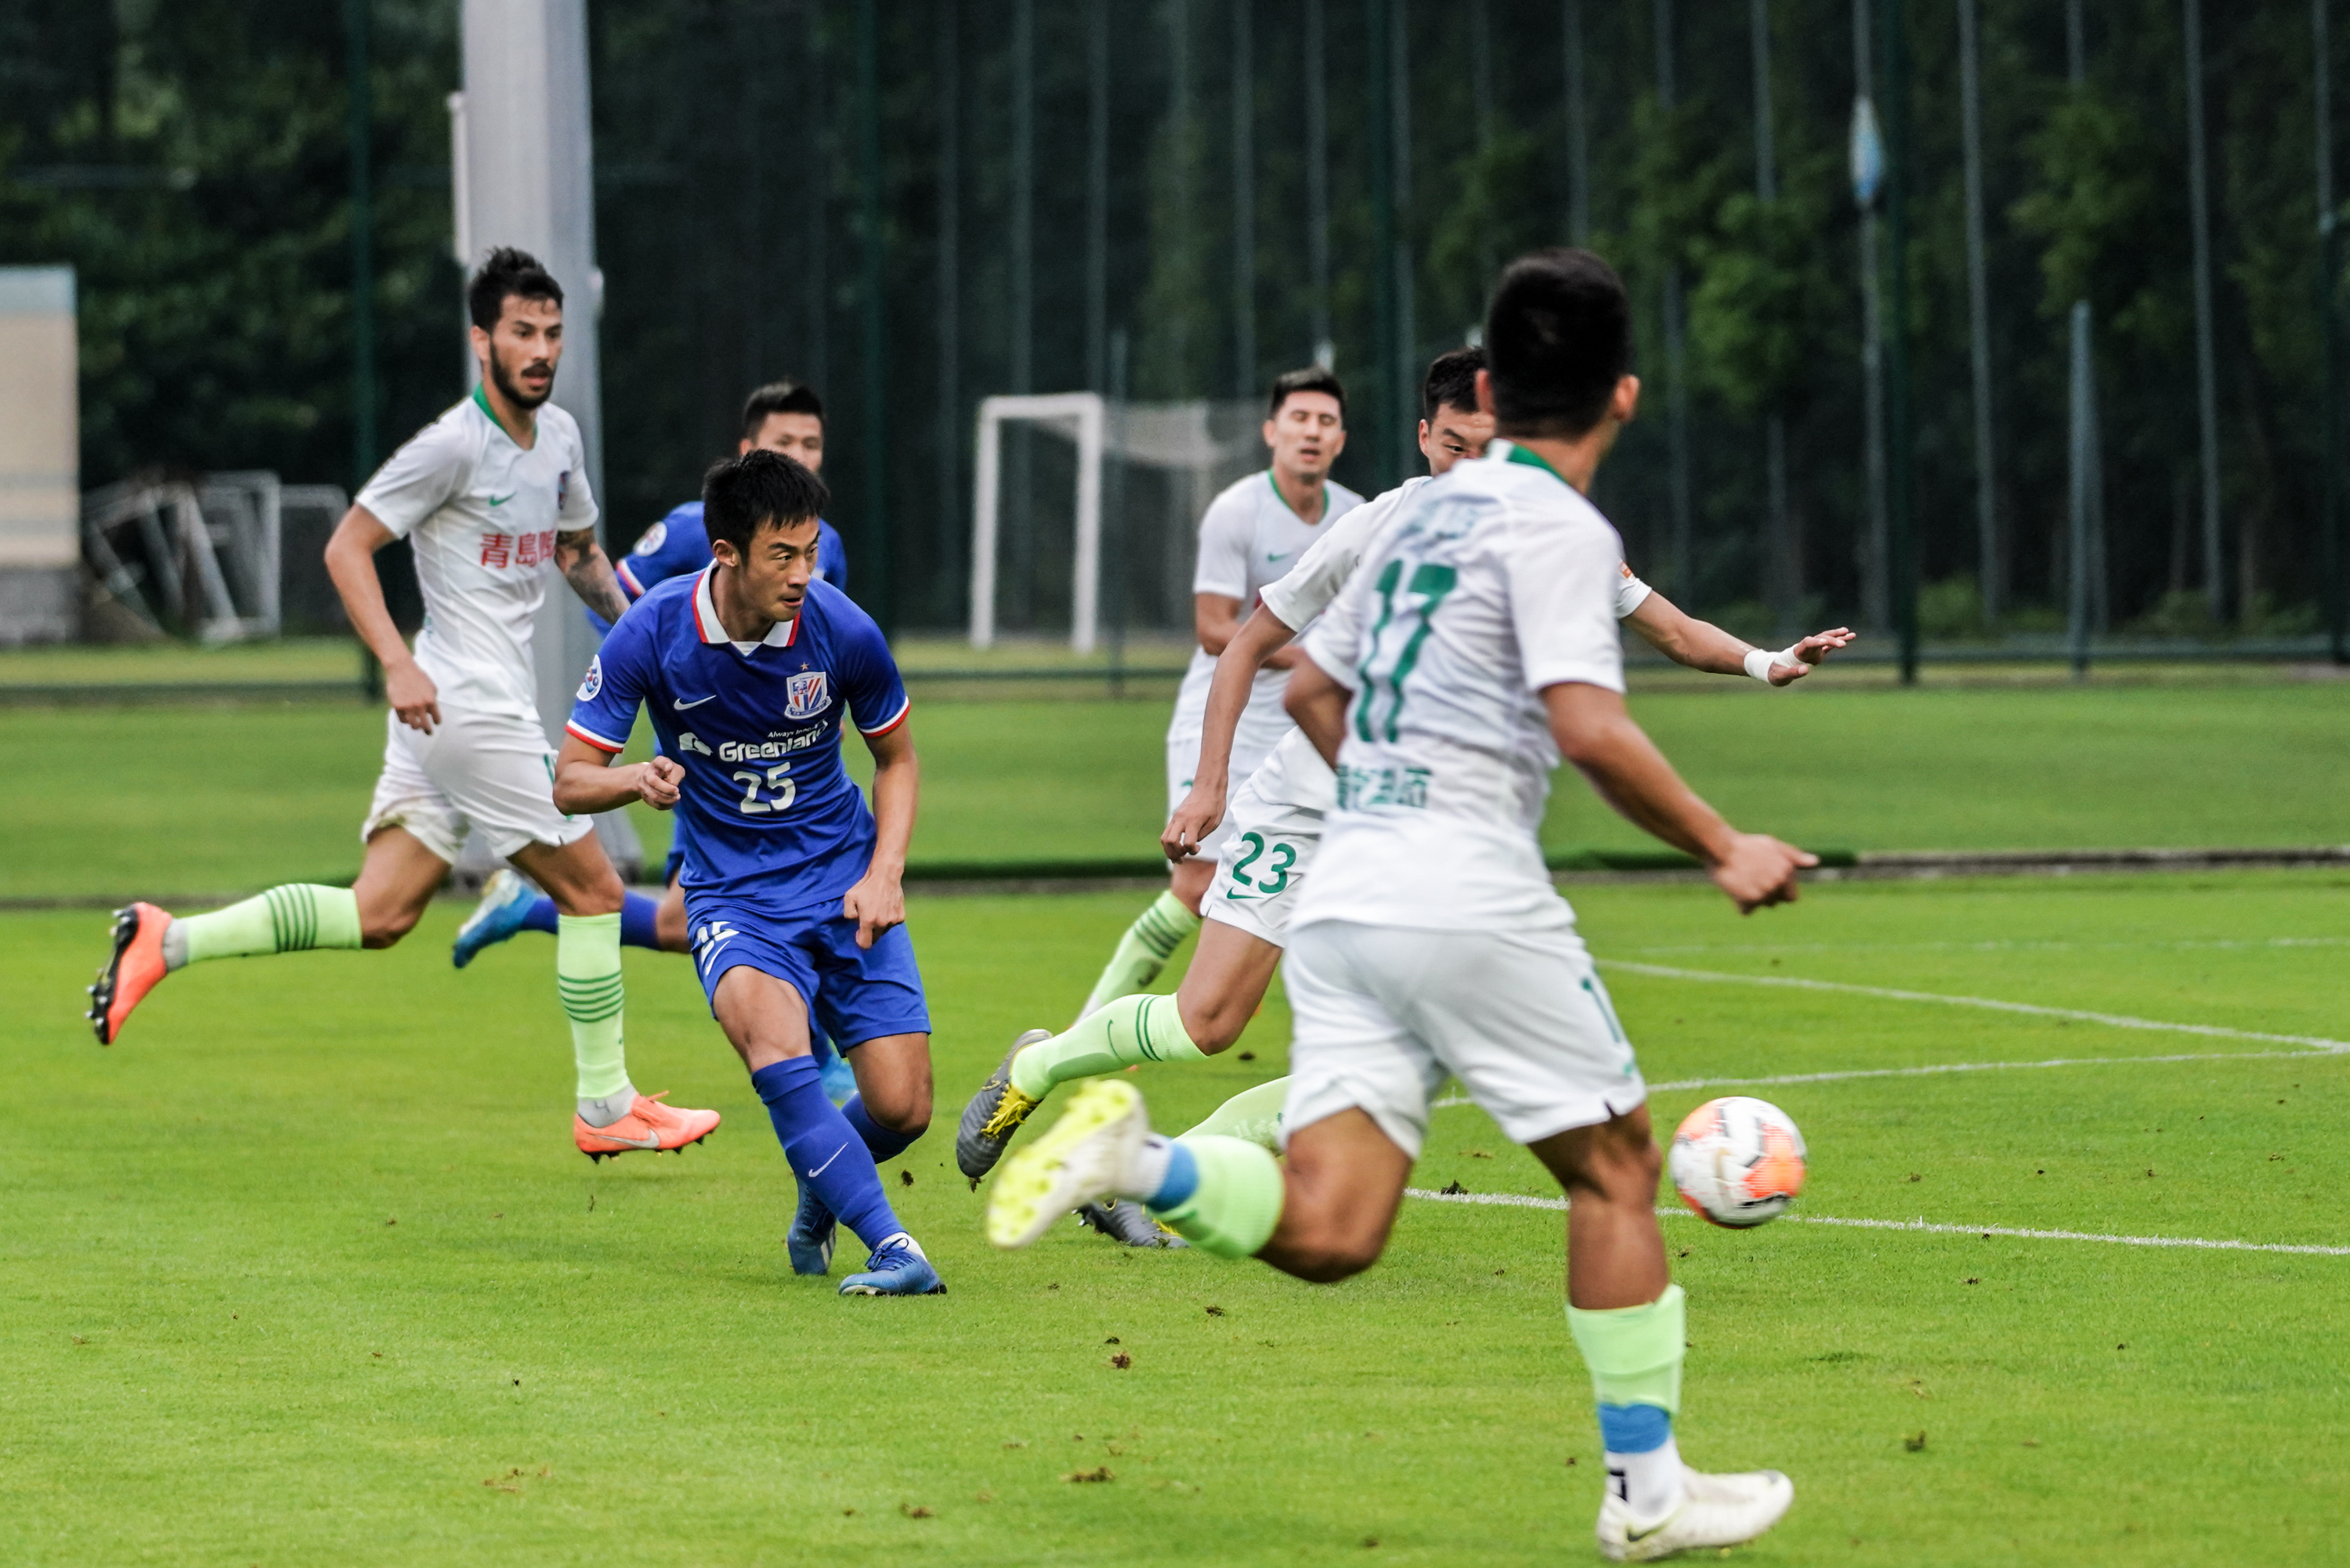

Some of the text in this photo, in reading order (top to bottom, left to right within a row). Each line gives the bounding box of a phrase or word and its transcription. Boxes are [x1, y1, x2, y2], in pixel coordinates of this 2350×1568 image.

[1355, 559, 1457, 743] 17
[733, 761, 796, 814] 25
[1232, 832, 1296, 894] 23
